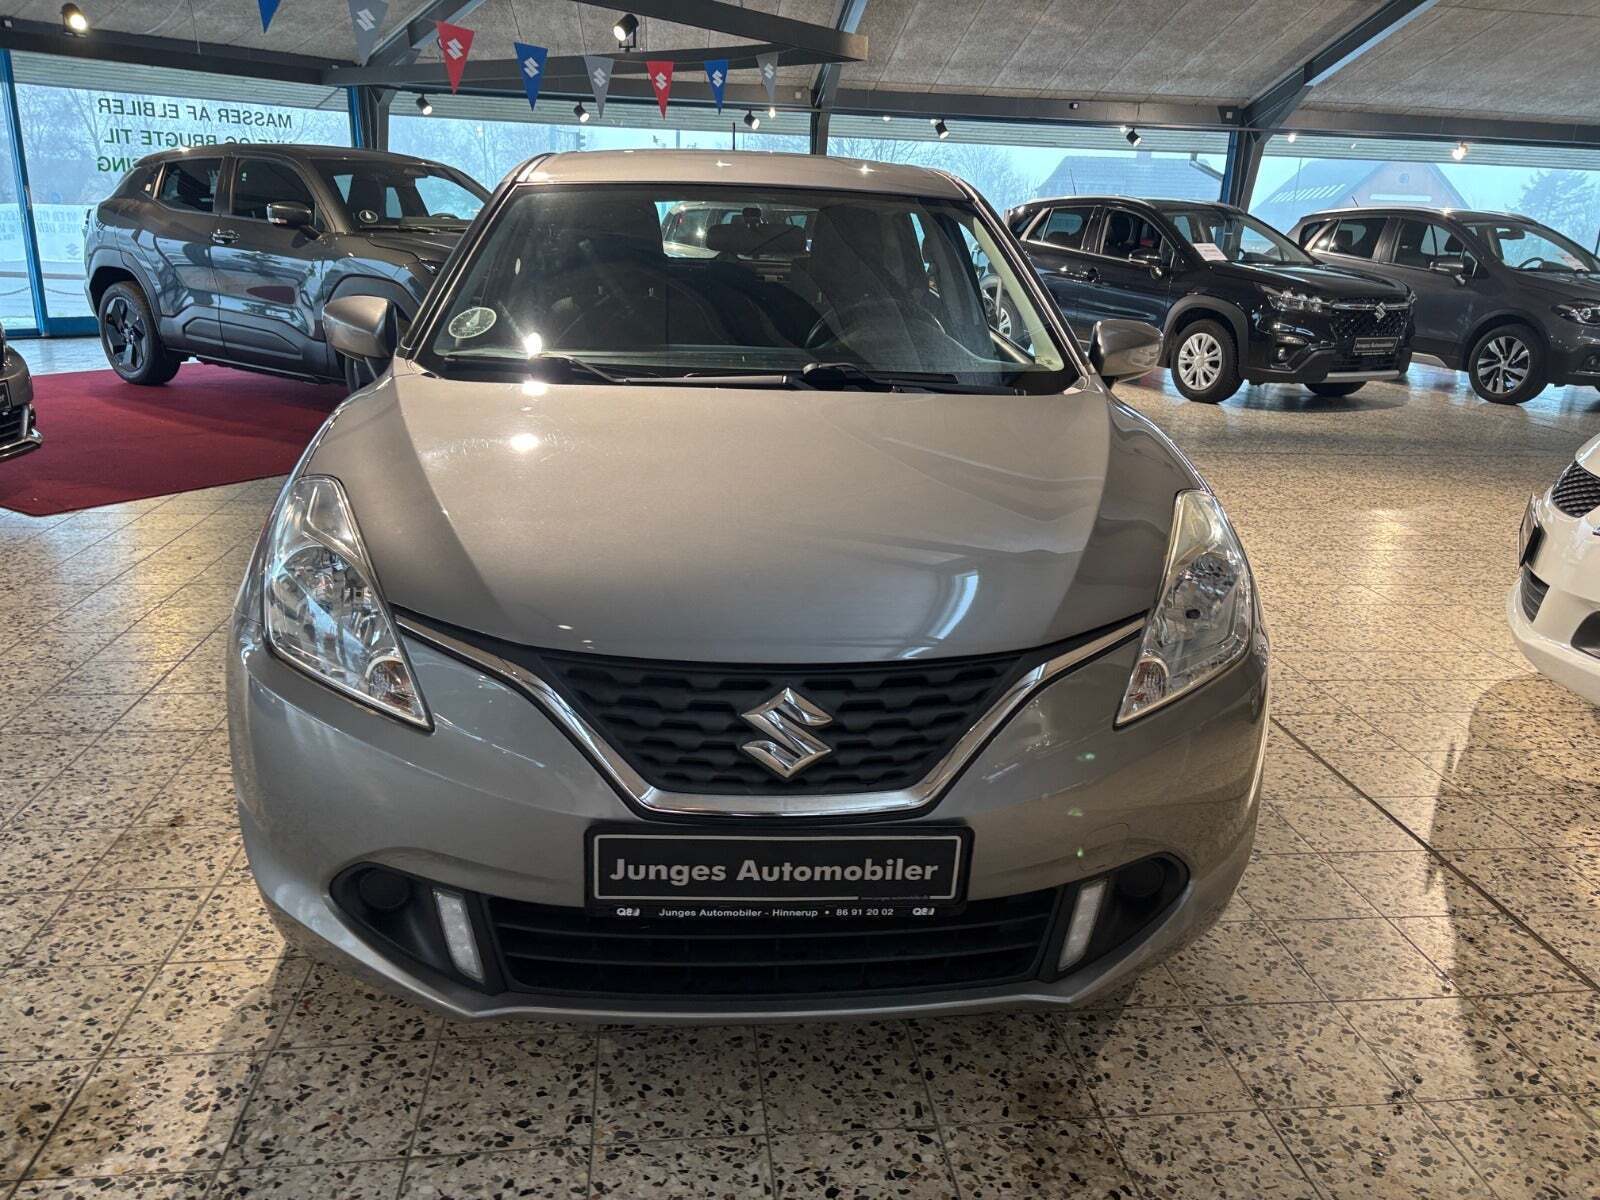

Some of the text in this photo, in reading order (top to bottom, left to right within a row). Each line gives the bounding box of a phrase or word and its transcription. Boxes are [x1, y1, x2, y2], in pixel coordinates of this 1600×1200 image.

[609, 858, 939, 887] Junges Automobiler
[659, 908, 697, 918] Junges
[699, 908, 762, 917] Automobiler
[772, 908, 818, 918] Hinnerup
[835, 908, 849, 916] 86
[851, 908, 862, 916] 91
[866, 908, 879, 916] 20
[881, 908, 894, 916] 02
